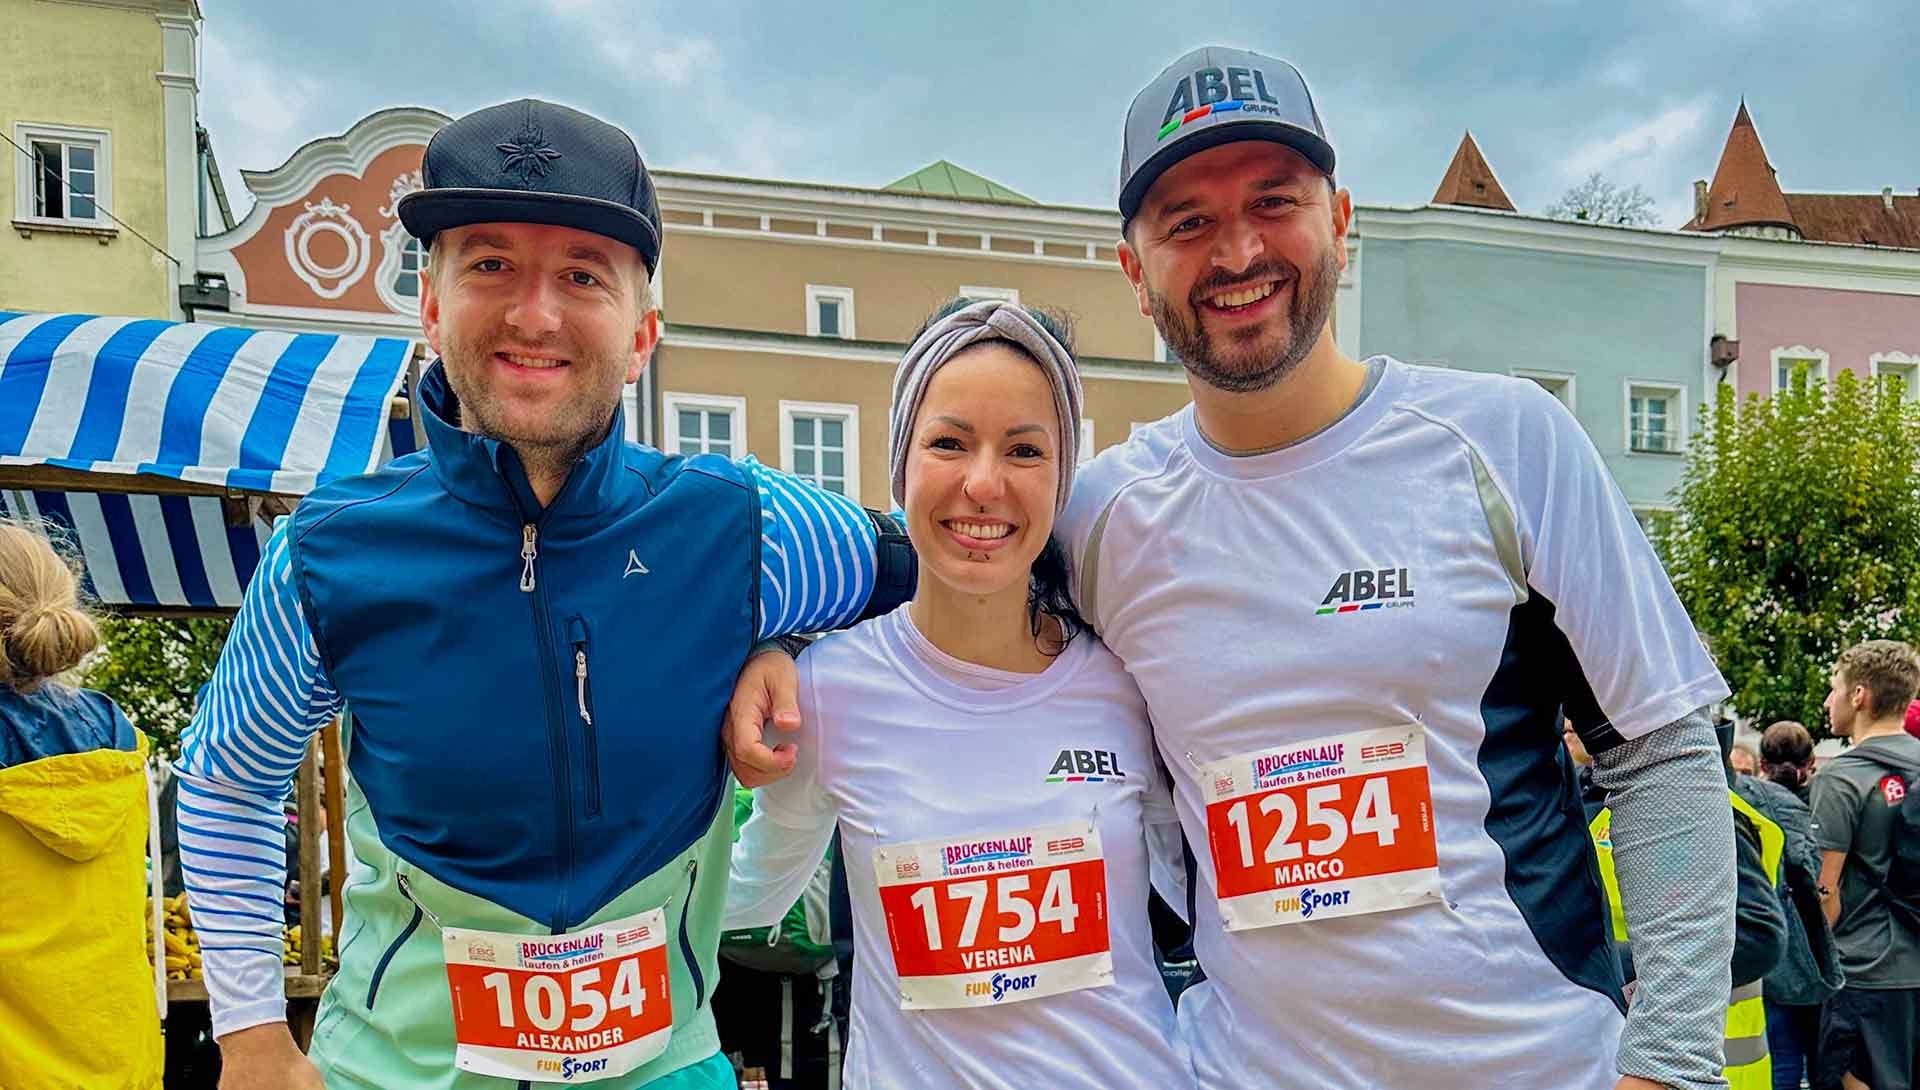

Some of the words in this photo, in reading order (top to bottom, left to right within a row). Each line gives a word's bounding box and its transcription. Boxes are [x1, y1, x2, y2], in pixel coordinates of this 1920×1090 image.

[1160, 66, 1279, 129] ABEL
[1320, 568, 1415, 606] ABEL
[1048, 749, 1127, 777] ABEL
[1257, 743, 1344, 778] BRÜCKENLAUF
[1361, 742, 1405, 759] ESB
[1260, 775, 1294, 789] laufen
[1296, 771, 1305, 782] &
[1307, 766, 1346, 780] helfen
[1227, 776, 1400, 869] 1254
[946, 836, 1032, 865] BRÜCKENLAUF
[1047, 837, 1085, 852] ESB
[896, 862, 920, 873] EBG
[949, 864, 985, 876] laufen
[987, 861, 995, 872] &
[997, 858, 1034, 870] helfen
[1274, 857, 1345, 886] MARCO
[910, 868, 1080, 951] 1754
[522, 932, 604, 959] BRÜCKENLAUF
[960, 944, 1036, 970] VERENA
[524, 960, 560, 970] laufen
[562, 960, 570, 969] &
[572, 952, 604, 966] helfen
[482, 957, 647, 1033] 1054
[516, 1026, 624, 1051] ALEXANDER
